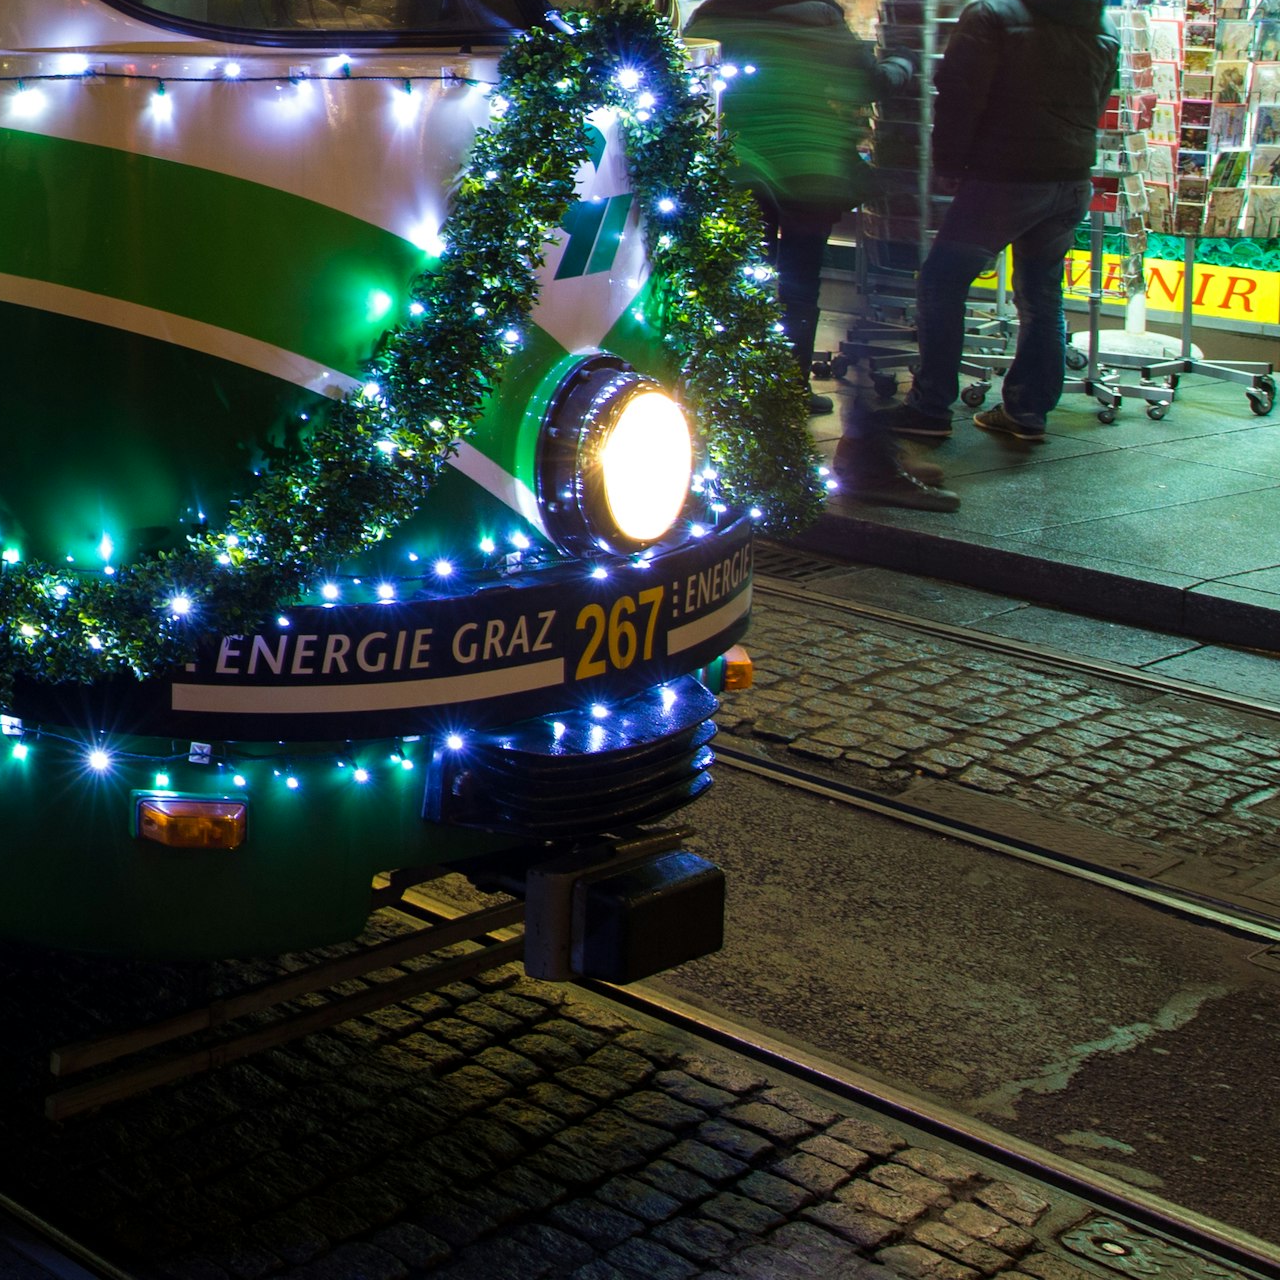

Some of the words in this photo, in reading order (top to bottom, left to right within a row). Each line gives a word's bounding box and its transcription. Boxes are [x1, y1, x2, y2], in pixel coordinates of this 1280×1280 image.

[684, 542, 751, 613] ENERGIE
[215, 627, 434, 675] ENERGIE
[451, 609, 557, 664] GRAZ
[574, 585, 665, 681] 267
